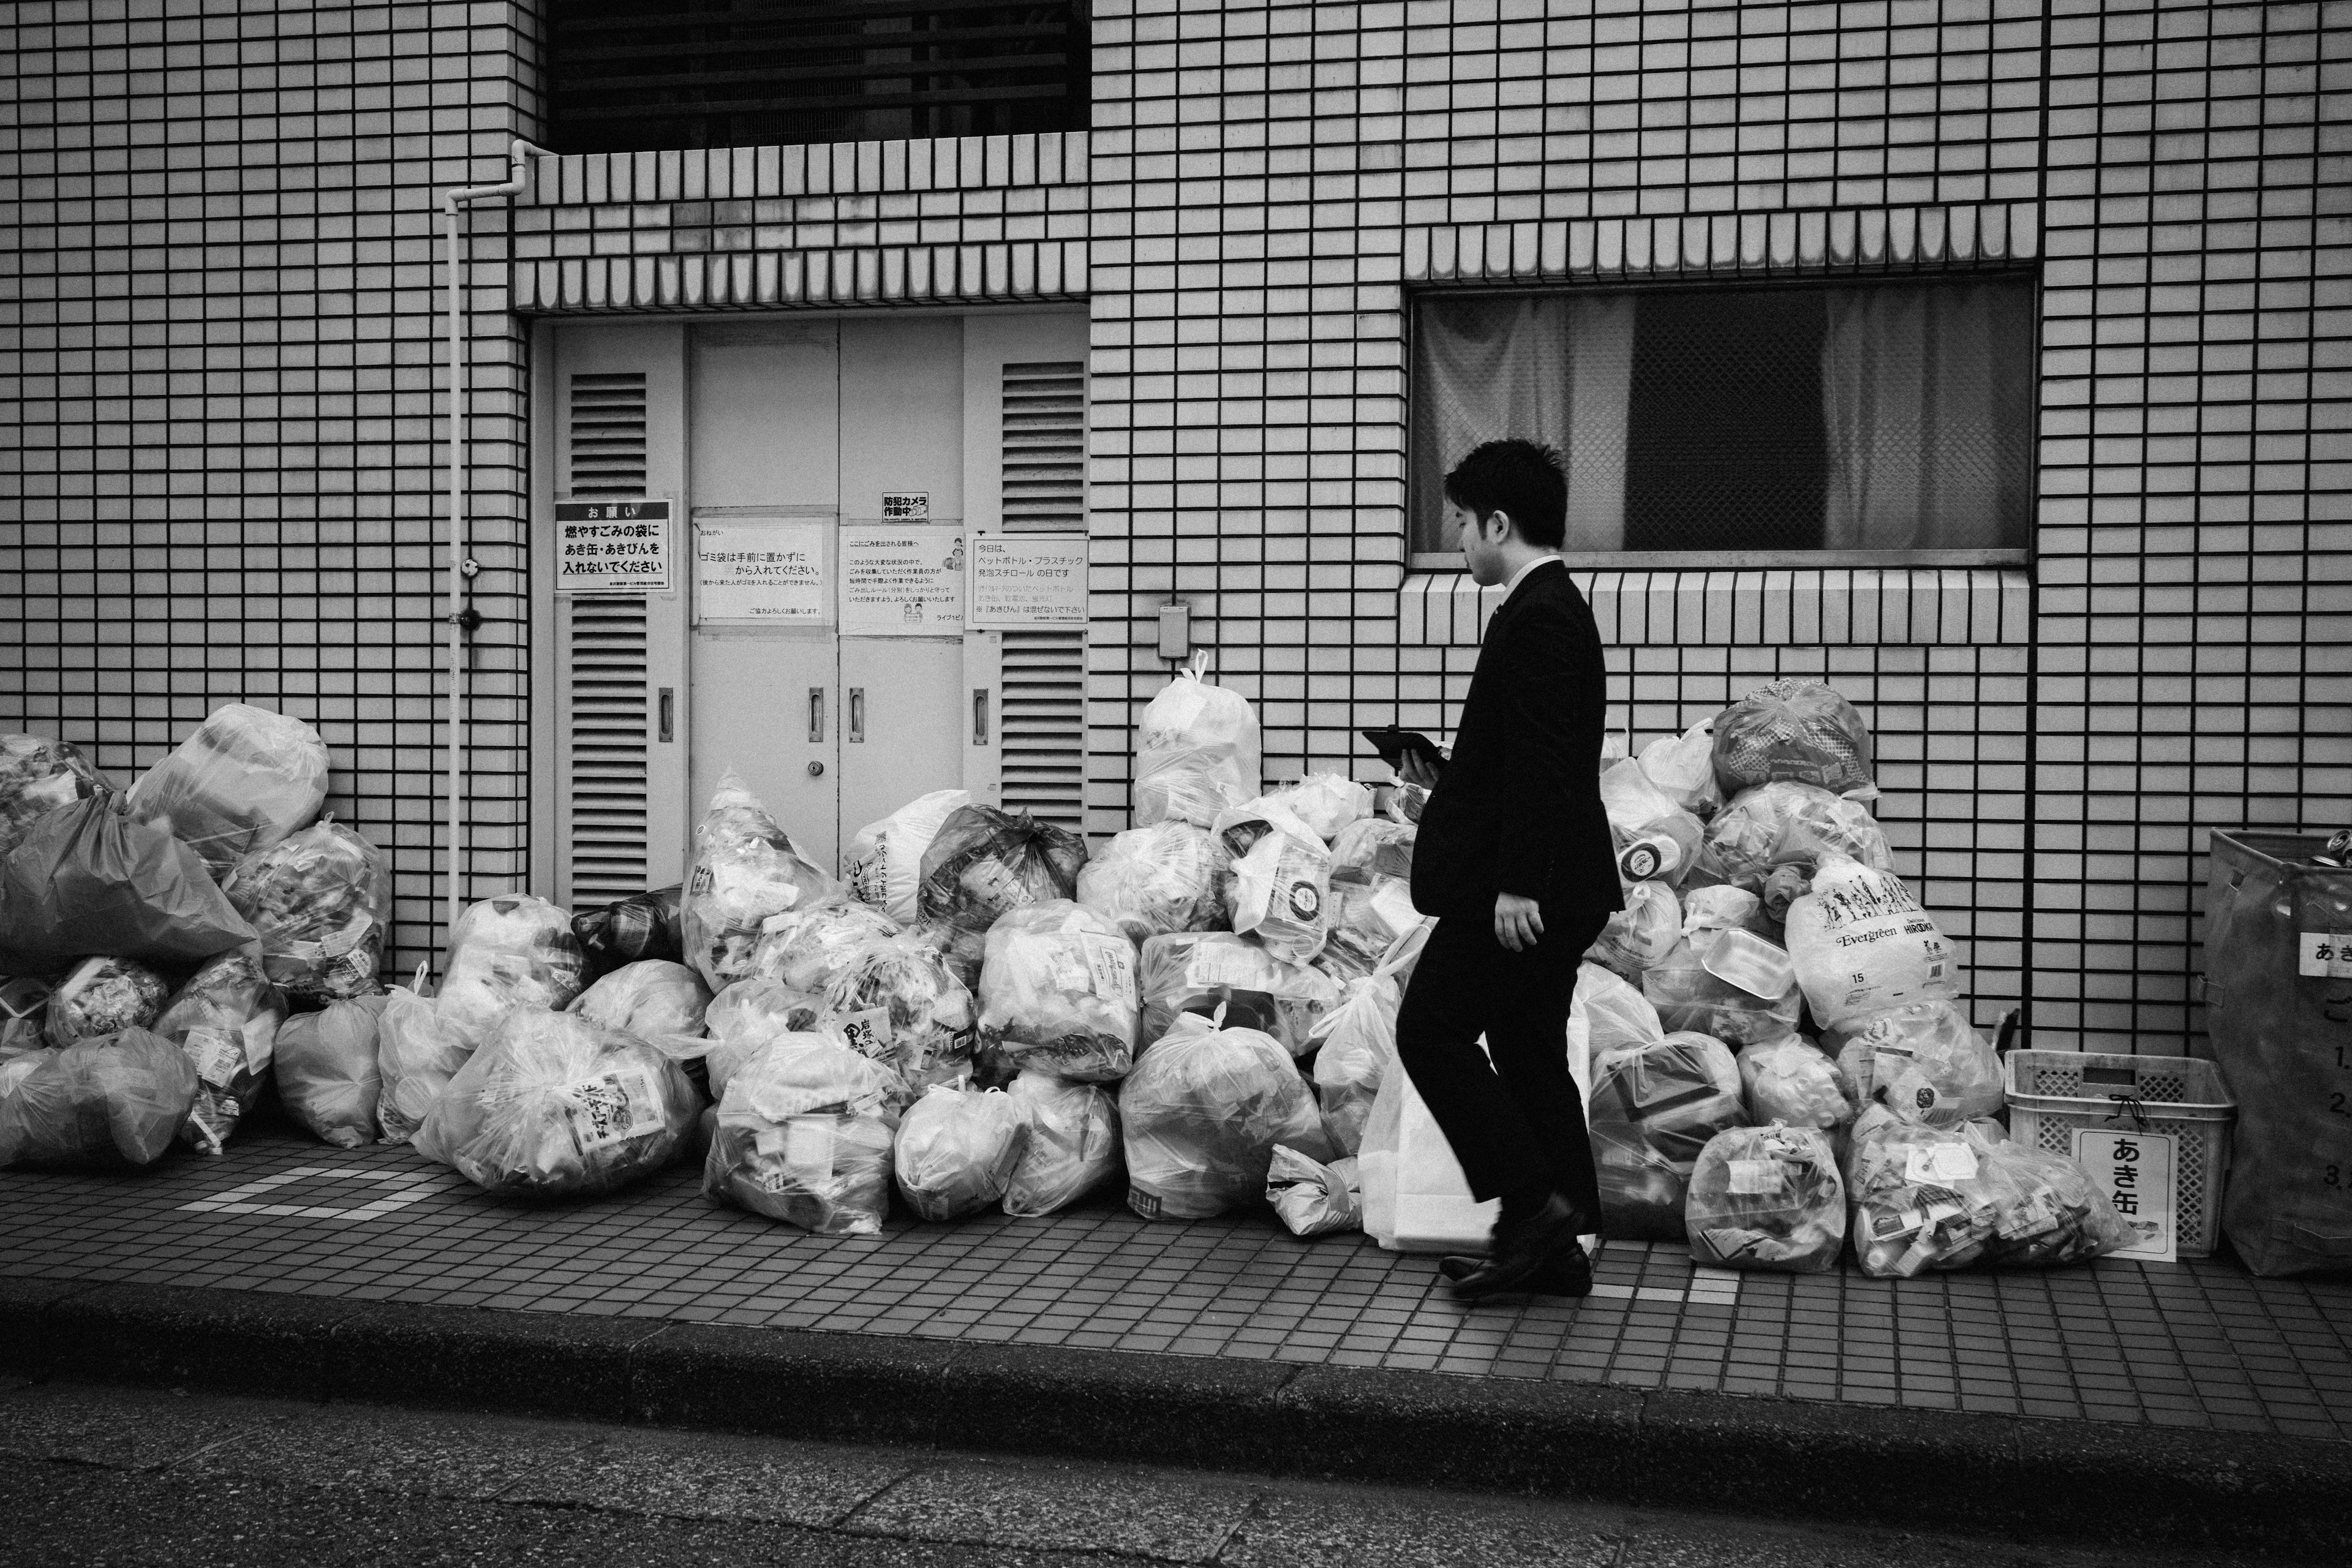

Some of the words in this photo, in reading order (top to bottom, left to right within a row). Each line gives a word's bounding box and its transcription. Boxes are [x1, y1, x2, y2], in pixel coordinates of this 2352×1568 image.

[884, 497, 927, 506] 防犯カメラ
[588, 506, 636, 519] お願い
[884, 507, 911, 516] 作動中
[565, 524, 659, 538] 燃やすごみの袋に
[565, 543, 660, 556] あき缶・あきびんを
[701, 552, 805, 562] ゴミ袋は手前に置かずに
[563, 560, 662, 573] 入れないでください
[1836, 928, 1897, 947] Evergreen
[1852, 973, 1864, 984] 15
[2112, 1138, 2140, 1216] あき缶
